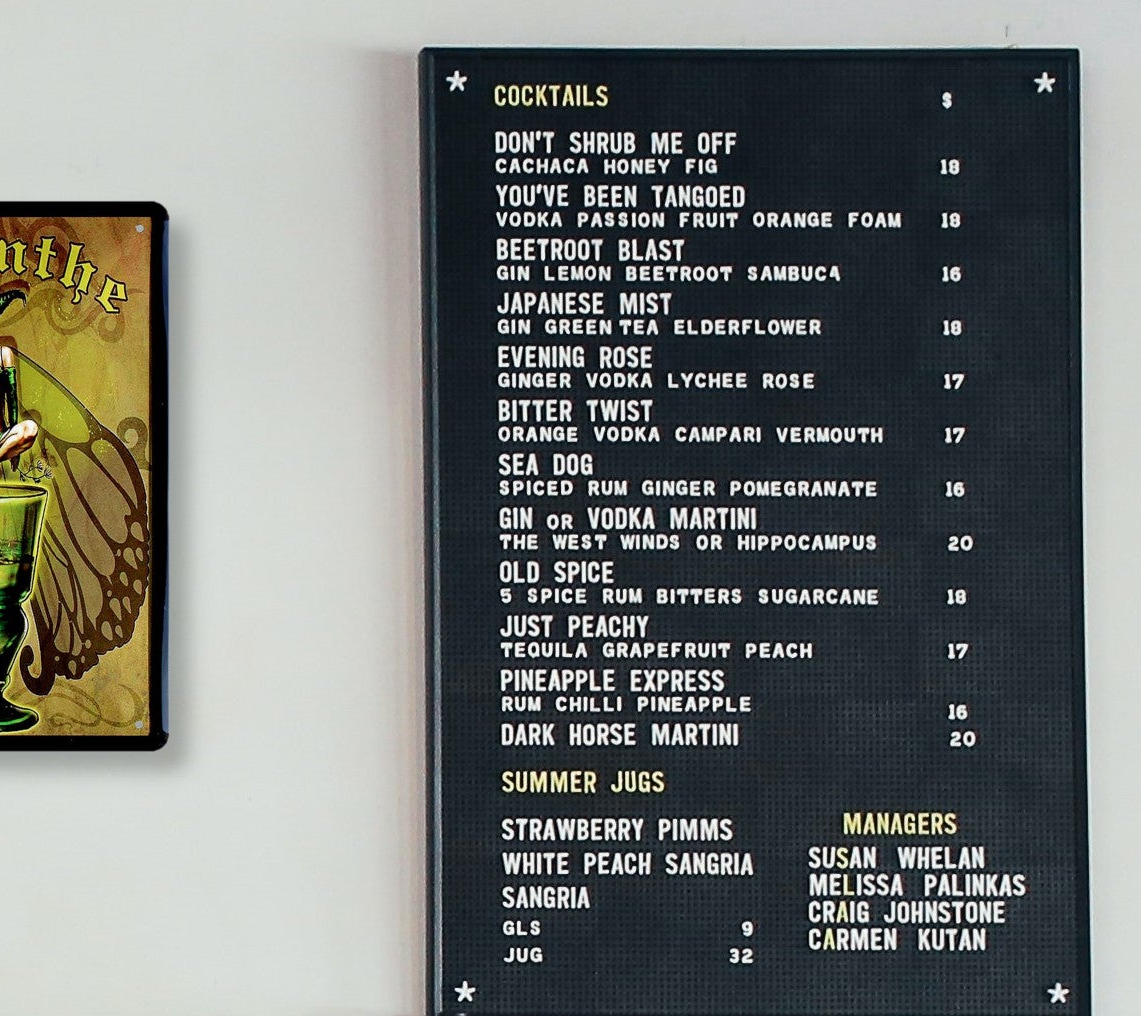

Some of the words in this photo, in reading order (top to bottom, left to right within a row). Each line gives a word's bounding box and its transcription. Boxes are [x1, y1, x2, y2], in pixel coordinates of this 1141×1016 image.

[494, 84, 609, 107] COCKTAILS
[941, 91, 953, 110] $
[494, 130, 555, 154] DON'T
[569, 131, 636, 155] SHRUB
[650, 131, 684, 155] ME
[697, 131, 737, 155] OFF
[495, 157, 589, 175] CACHACA
[603, 158, 671, 175] HONEY
[685, 158, 718, 175] FIG
[940, 158, 960, 176] 18
[495, 183, 569, 208] YOU'VE
[583, 184, 638, 208] BEEN
[650, 184, 746, 209] TANGOED
[495, 211, 563, 228] VODKA
[577, 211, 665, 229] PASSION
[679, 211, 739, 229] FRUIT
[752, 211, 833, 229] ORANGE
[847, 211, 902, 229] FOAM
[941, 212, 961, 229] 18
[496, 238, 604, 262] BEETROOT
[618, 238, 685, 262] BLAST
[496, 264, 530, 282] GIN
[544, 265, 612, 282] LEMON
[625, 265, 733, 282] BEETROOT
[747, 265, 841, 282] SAMBUCA
[941, 265, 962, 283] 16
[496, 291, 605, 315] JAPANESE
[619, 292, 673, 316] MIST
[497, 318, 531, 335] GIN
[544, 318, 613, 336] GREEN
[618, 318, 659, 336] TEA
[673, 318, 822, 336] ELDERFLOWER
[942, 319, 962, 336] 18
[497, 345, 585, 369] EVENING
[599, 345, 653, 370] ROSE
[497, 372, 572, 389] GINGER
[585, 372, 653, 389] VODKA
[667, 372, 748, 389] LYCHEE
[762, 372, 815, 390] ROSE
[943, 373, 965, 390] 17
[498, 399, 573, 423] BITTER
[585, 399, 654, 423] TWIST
[497, 425, 579, 443] ORANGE
[593, 425, 661, 443] VODKA
[674, 426, 762, 443] CAMPARI
[775, 426, 884, 444] VERMOUTH
[944, 427, 966, 444] 17
[498, 452, 539, 477] SEA
[552, 453, 594, 476] DOG
[499, 479, 574, 497] SPICED
[587, 479, 628, 497] RUM
[641, 479, 716, 497] GINGER
[729, 480, 878, 498] POMEGRANATE
[945, 480, 965, 498] 16
[499, 506, 533, 530] GIN
[546, 513, 574, 531] OR
[586, 506, 656, 530] VODKA
[669, 506, 757, 531] MARTINI
[499, 533, 539, 551] THE
[552, 533, 608, 551] WEST
[619, 533, 680, 551] WINDS
[695, 534, 723, 551] OR
[737, 534, 877, 552] HIPPOCAMPUS
[947, 535, 974, 552] 20
[499, 560, 540, 584] OLD
[553, 560, 615, 584] SPICE
[499, 587, 512, 604] 5
[527, 587, 587, 605] SPICE
[602, 587, 643, 605] RUM
[656, 587, 743, 605] BITTERS
[758, 588, 879, 606] SUGARCANE
[947, 588, 967, 606] 18
[499, 614, 554, 638] JUST
[567, 614, 649, 639] PEACHY
[500, 641, 588, 659] TEQUILA
[602, 641, 731, 659] GRAPEFRUIT
[745, 642, 813, 659] PEACH
[947, 642, 969, 660] 17
[500, 668, 616, 693] PINEAPPLE
[630, 669, 725, 693] EXPRESS
[501, 695, 542, 712] RUM
[555, 695, 623, 713] CHILLI
[637, 695, 752, 713] PINEAPPLE
[947, 703, 968, 721] 16
[501, 722, 556, 747] DARK
[569, 722, 637, 747] HORSE
[651, 722, 739, 747] MARTINI
[949, 730, 977, 748] 20
[501, 770, 597, 794] SUMMER
[610, 770, 665, 793] JUGS
[501, 817, 644, 842] STRAWBERRY
[658, 817, 734, 842] PIMMS
[843, 812, 958, 836] MANAGERS
[502, 851, 570, 876] WHITE
[583, 851, 652, 876] PEACH
[664, 852, 754, 876] SANGRIA
[808, 845, 877, 870] SUSAN
[897, 845, 985, 870] WHELAN
[502, 885, 591, 910] SANGRIA
[809, 872, 904, 897] MELISSA
[924, 873, 1027, 898] PALINKAS
[808, 900, 870, 924] CRAIG
[883, 900, 1006, 925] JOHNSTONE
[502, 920, 541, 936] GLS
[741, 920, 754, 937] 9
[808, 927, 898, 951] CARMEN
[917, 927, 987, 952] KUTAN
[503, 946, 543, 964] JUG
[729, 947, 754, 964] 32
